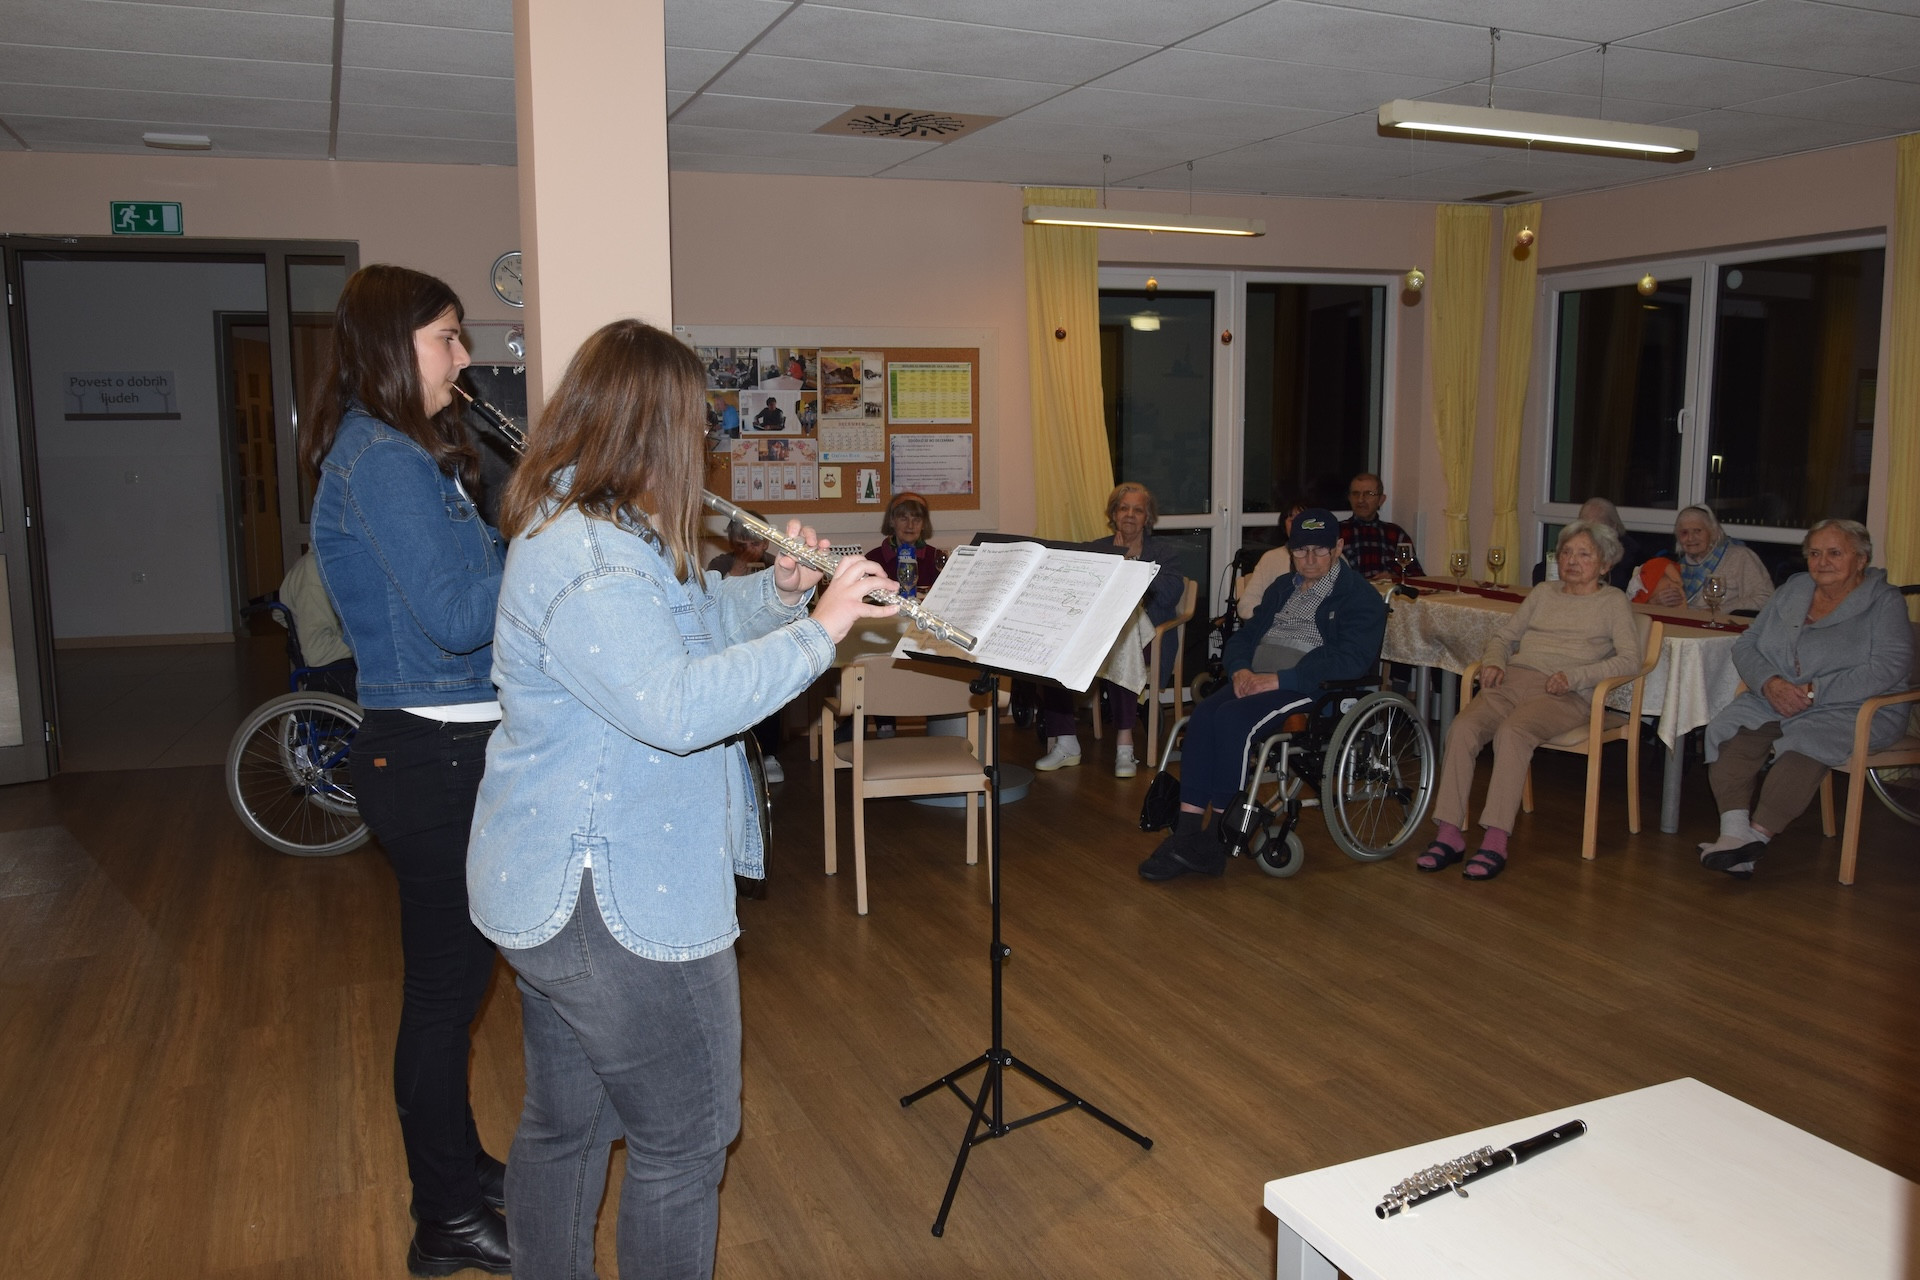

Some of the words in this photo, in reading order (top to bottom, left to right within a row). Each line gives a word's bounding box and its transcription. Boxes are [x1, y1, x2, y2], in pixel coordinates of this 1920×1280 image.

[69, 377, 112, 387] Povest
[116, 379, 124, 387] o
[127, 376, 167, 387] dobrih
[101, 392, 139, 405] ljudeh
